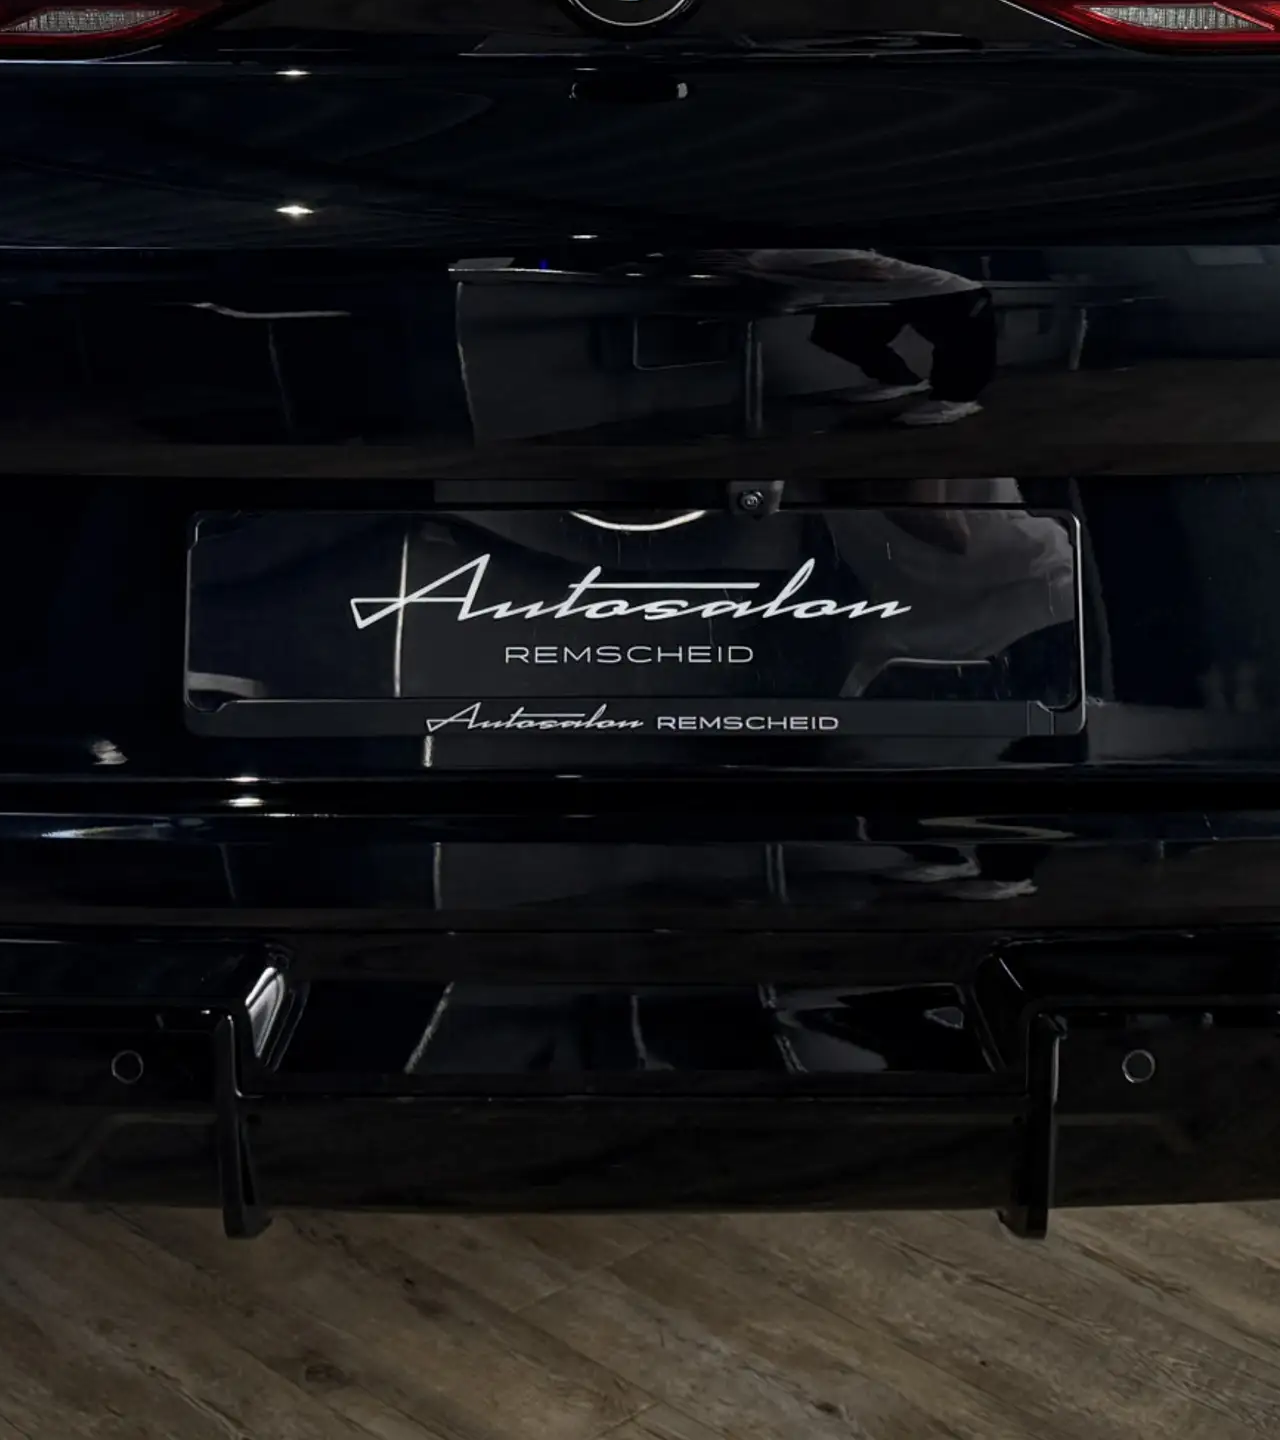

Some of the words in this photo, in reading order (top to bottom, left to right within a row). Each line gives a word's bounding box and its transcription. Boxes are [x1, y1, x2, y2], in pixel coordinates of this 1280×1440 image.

[349, 553, 913, 630] Autosalon
[504, 645, 754, 664] REMSCHEID
[425, 701, 644, 732] Autosalon
[656, 716, 839, 731] REMSCHEID
